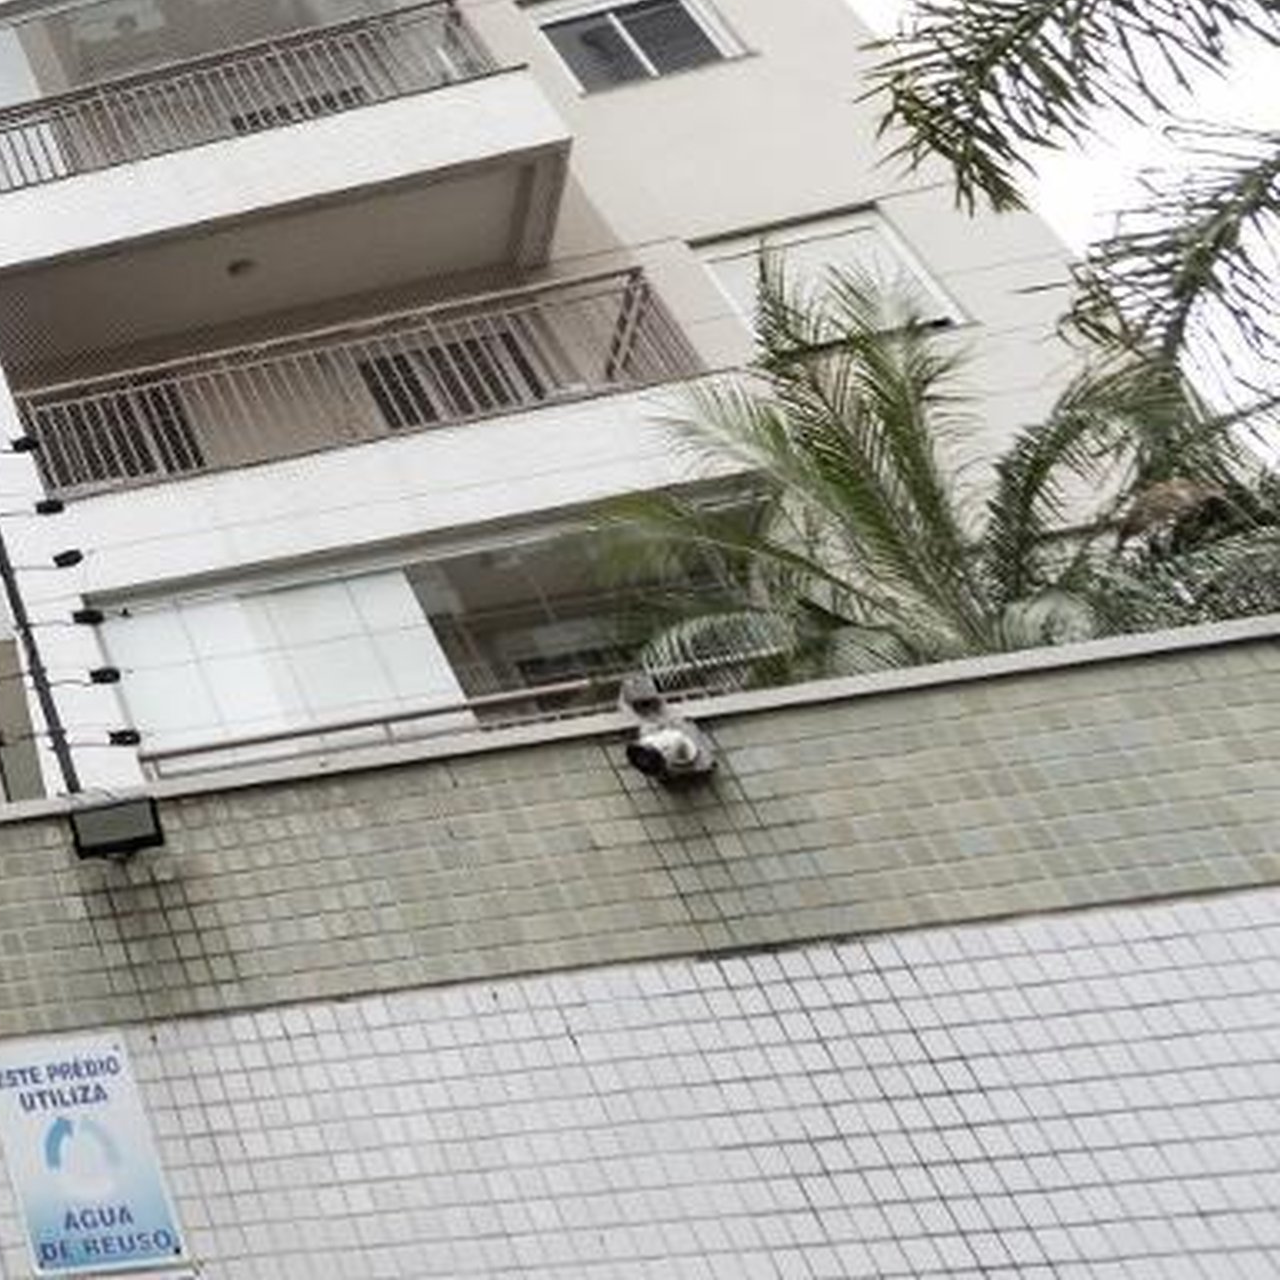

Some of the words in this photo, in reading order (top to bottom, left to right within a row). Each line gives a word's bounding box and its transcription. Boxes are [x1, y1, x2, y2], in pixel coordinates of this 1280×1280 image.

[20, 1083, 107, 1112] UTILIZA
[40, 1240, 74, 1261] DE
[86, 1229, 171, 1256] REUSO
